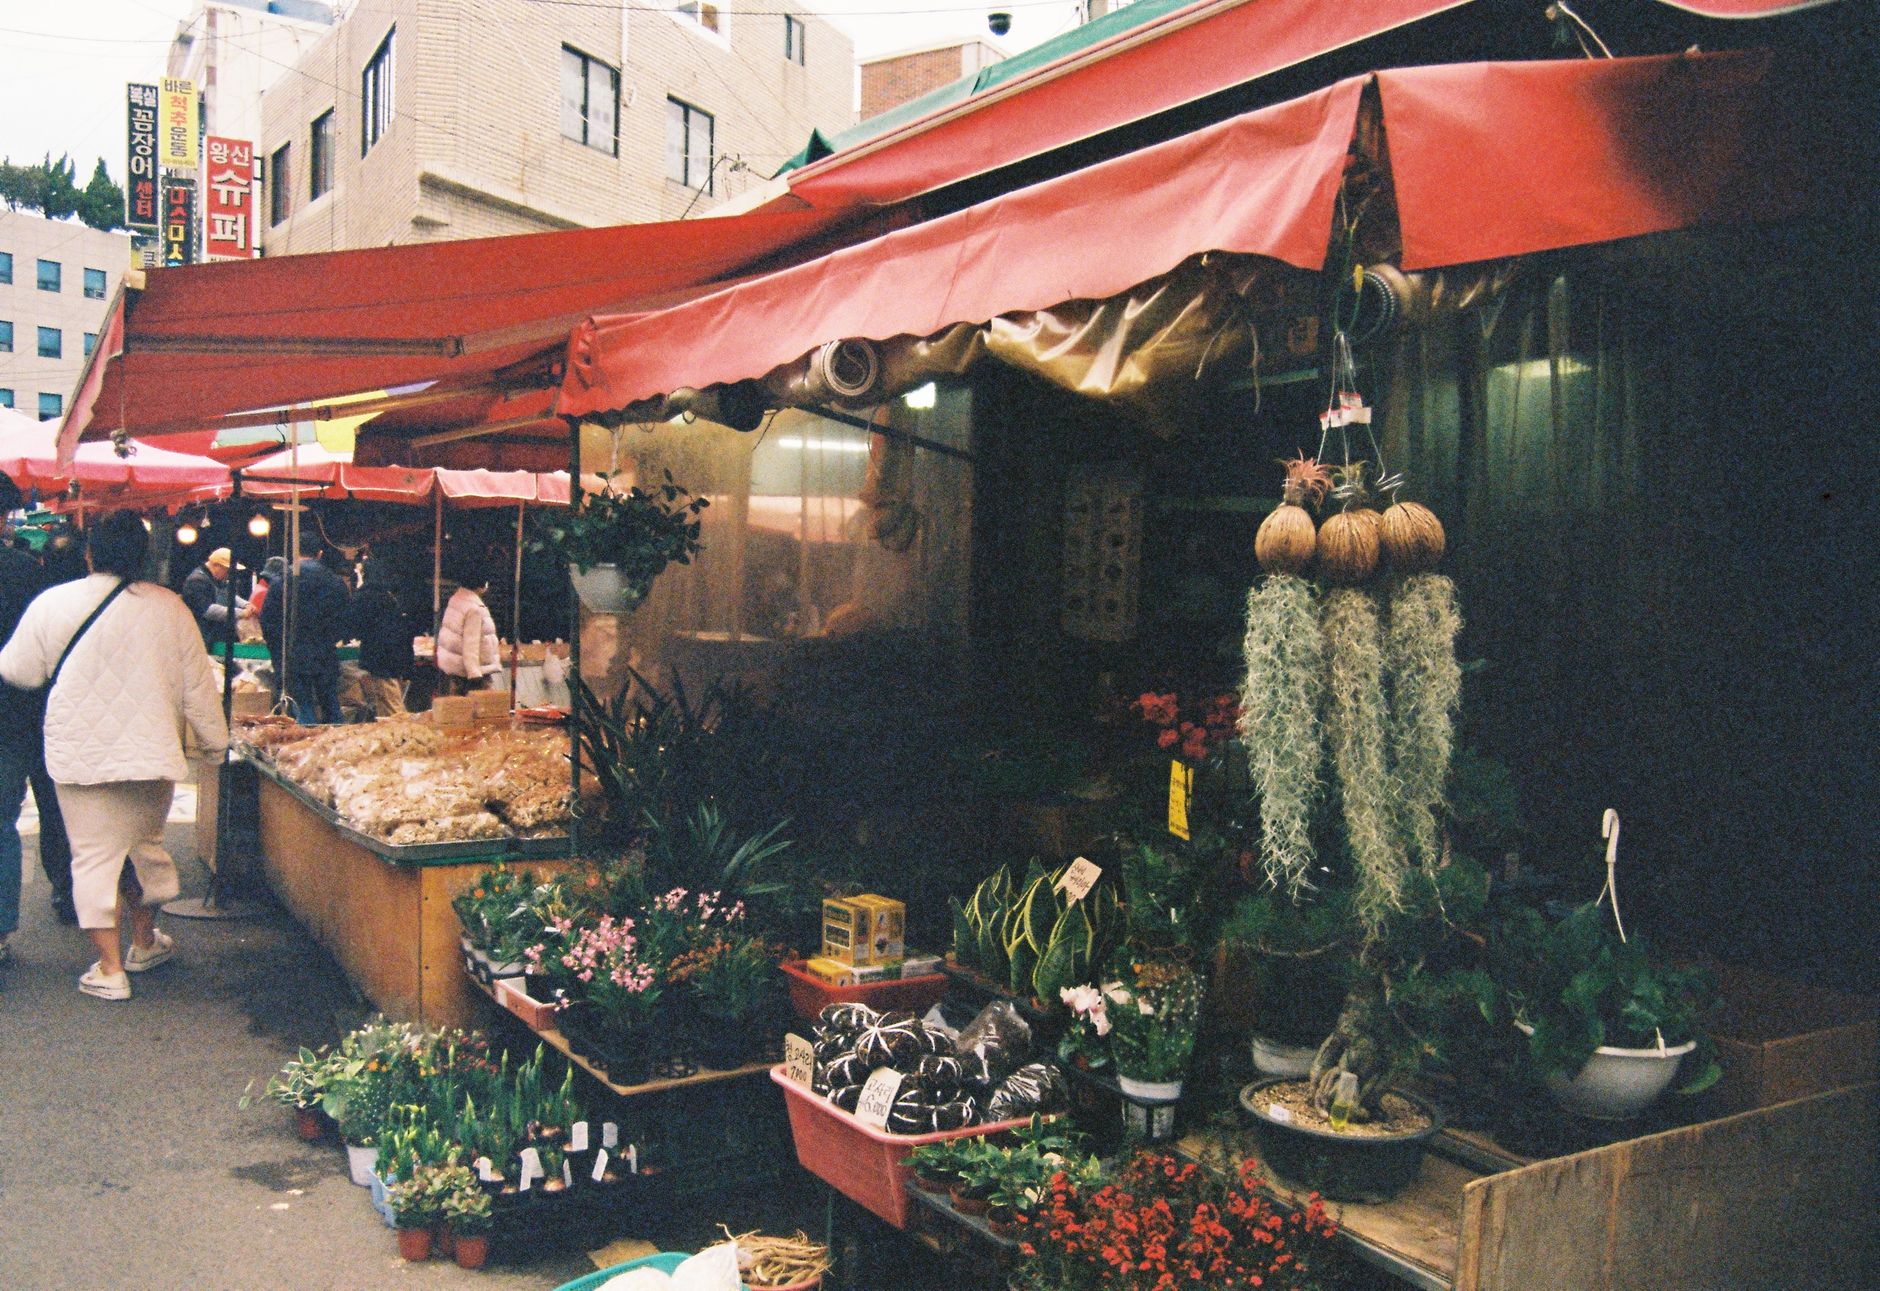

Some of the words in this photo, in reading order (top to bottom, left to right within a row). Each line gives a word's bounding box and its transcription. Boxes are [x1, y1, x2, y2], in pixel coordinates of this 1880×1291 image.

[164, 79, 193, 95] 바른
[170, 95, 188, 127] 척추
[131, 108, 155, 179] 꼼장어
[210, 142, 250, 167] 왕신
[135, 181, 153, 218] 센터
[210, 169, 251, 251] 슈퍼
